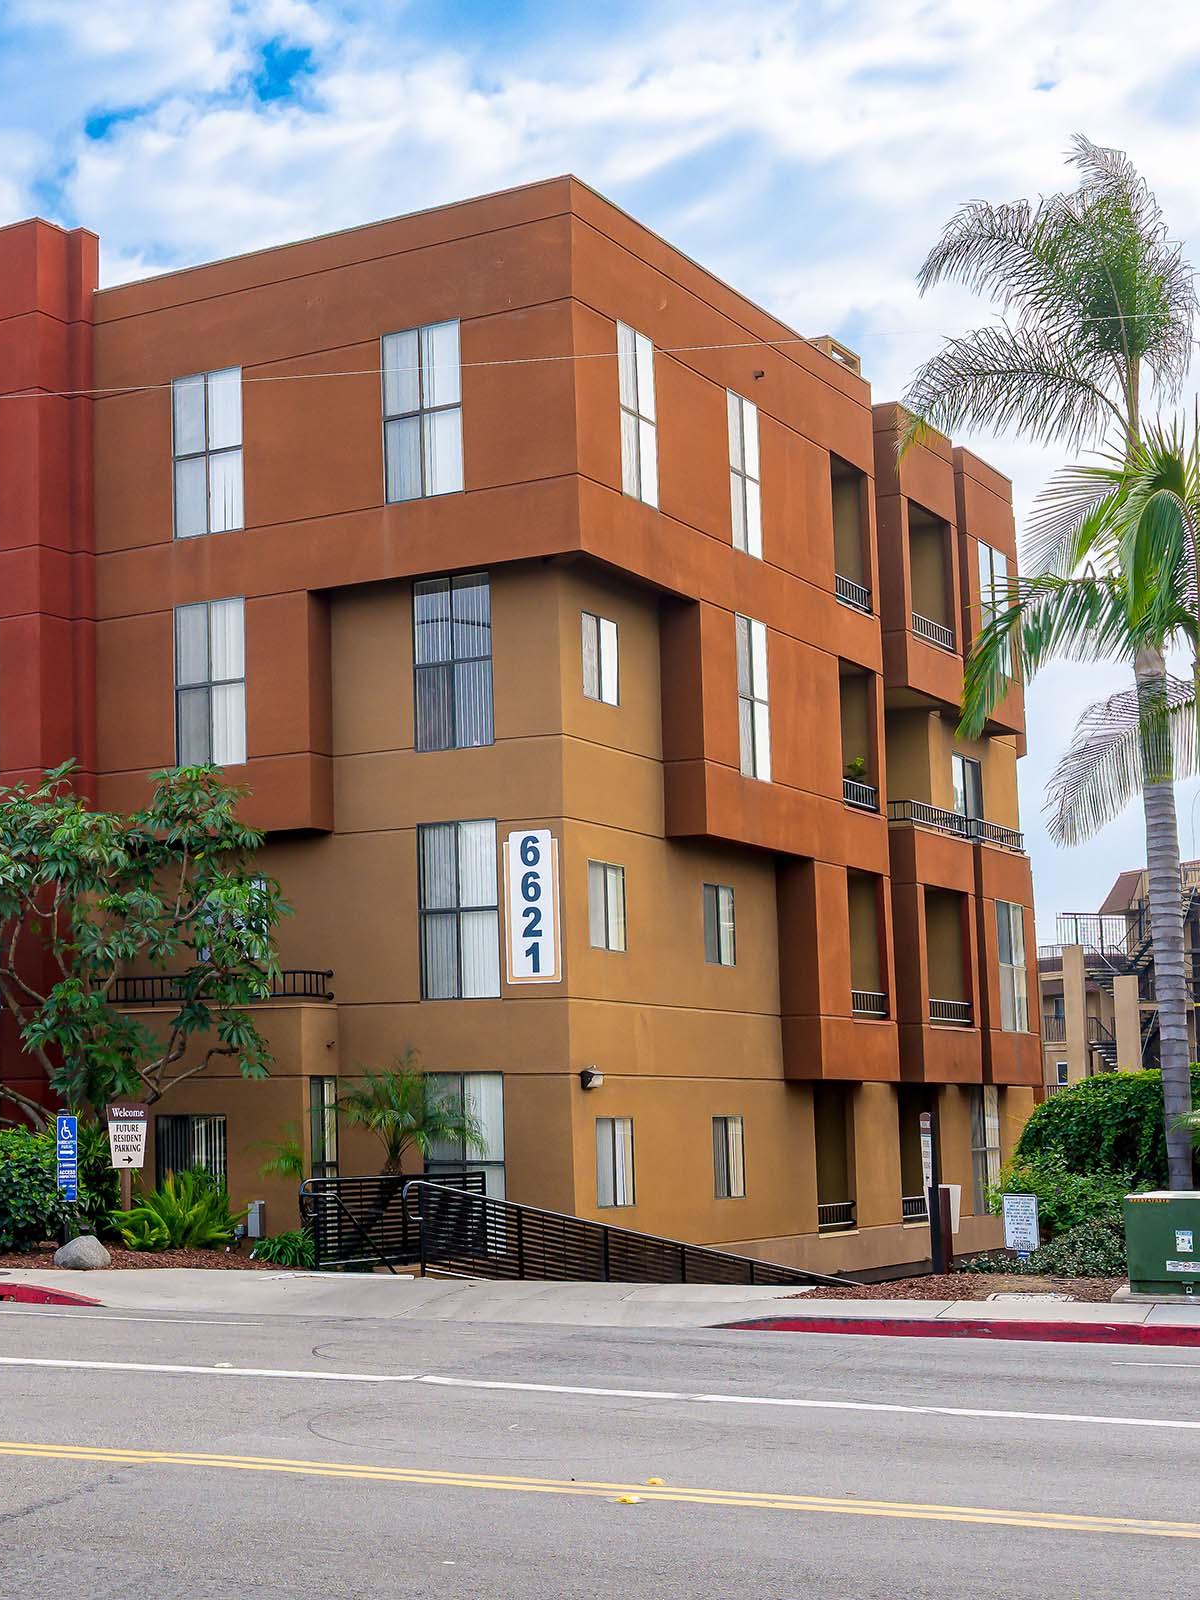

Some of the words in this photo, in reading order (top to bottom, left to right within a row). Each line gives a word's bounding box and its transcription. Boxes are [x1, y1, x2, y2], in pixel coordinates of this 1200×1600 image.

[519, 835, 543, 973] 6621
[111, 1107, 145, 1117] Welcome
[116, 1124, 139, 1132] FUTURE
[113, 1134, 142, 1143] RESIDENT
[114, 1144, 141, 1153] PARKING
